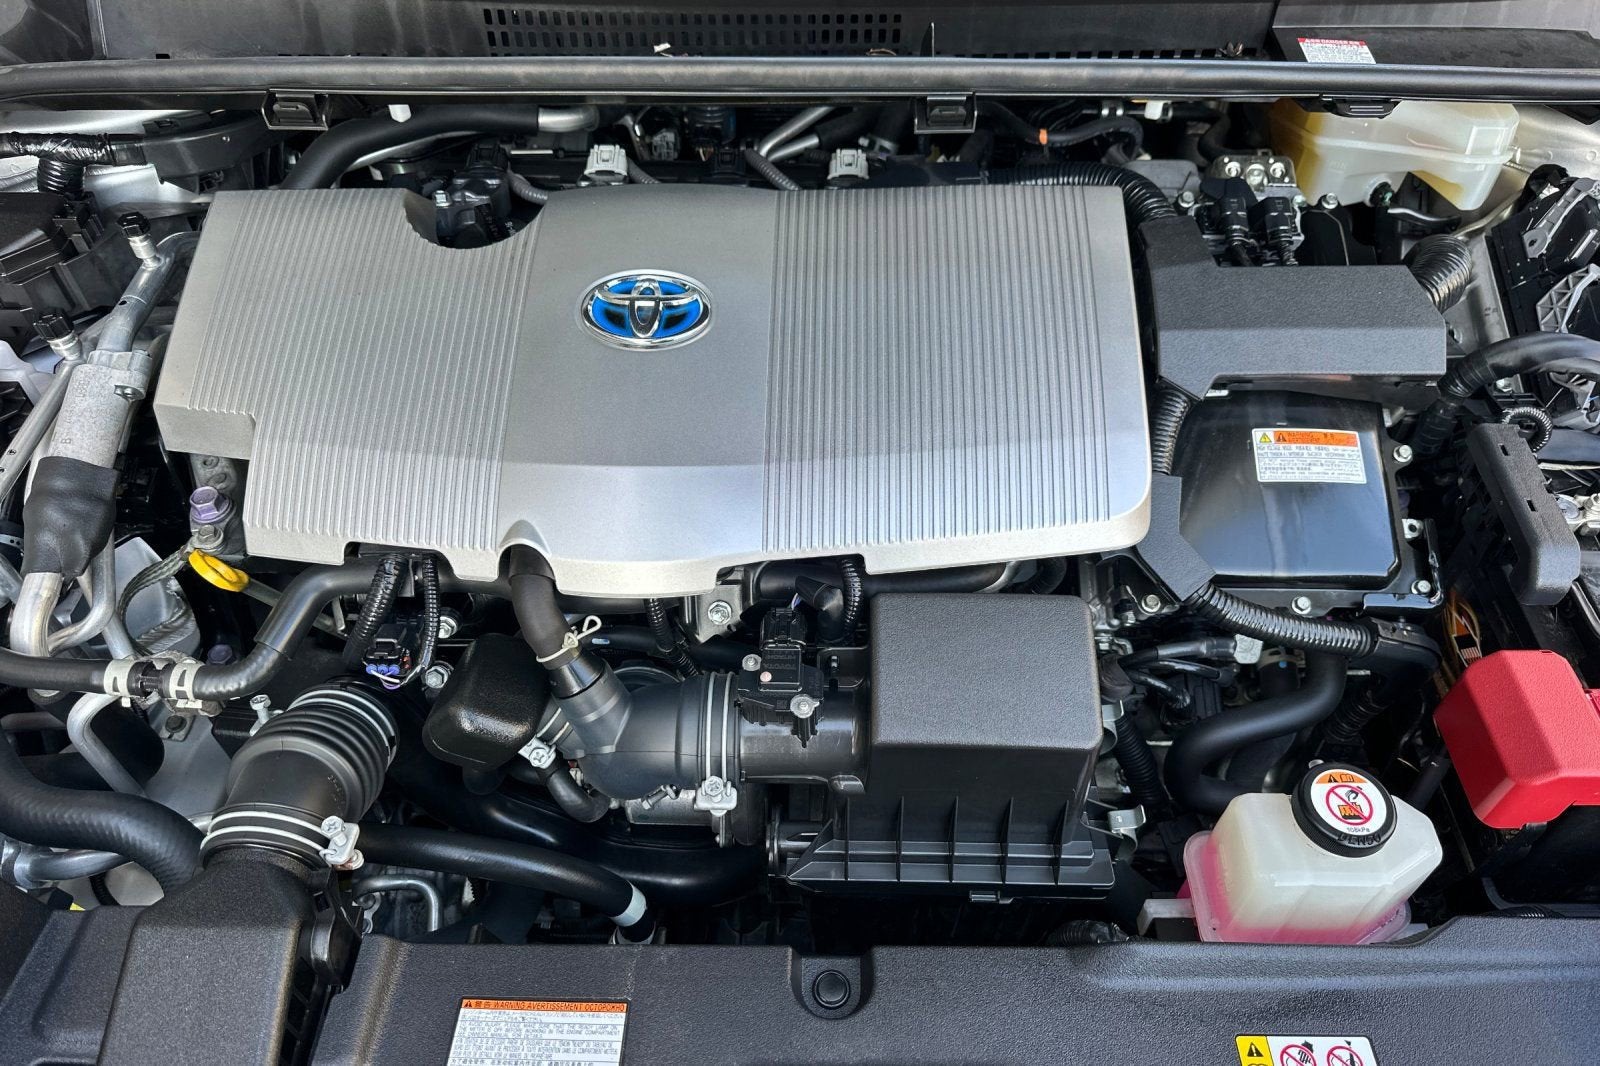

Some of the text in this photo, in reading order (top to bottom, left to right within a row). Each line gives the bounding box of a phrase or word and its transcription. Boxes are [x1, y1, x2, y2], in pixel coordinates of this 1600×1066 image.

[1337, 832, 1382, 846] DENSO
[494, 1000, 525, 1008] WARNING
[527, 1001, 581, 1010] AVERTISSEMENT
